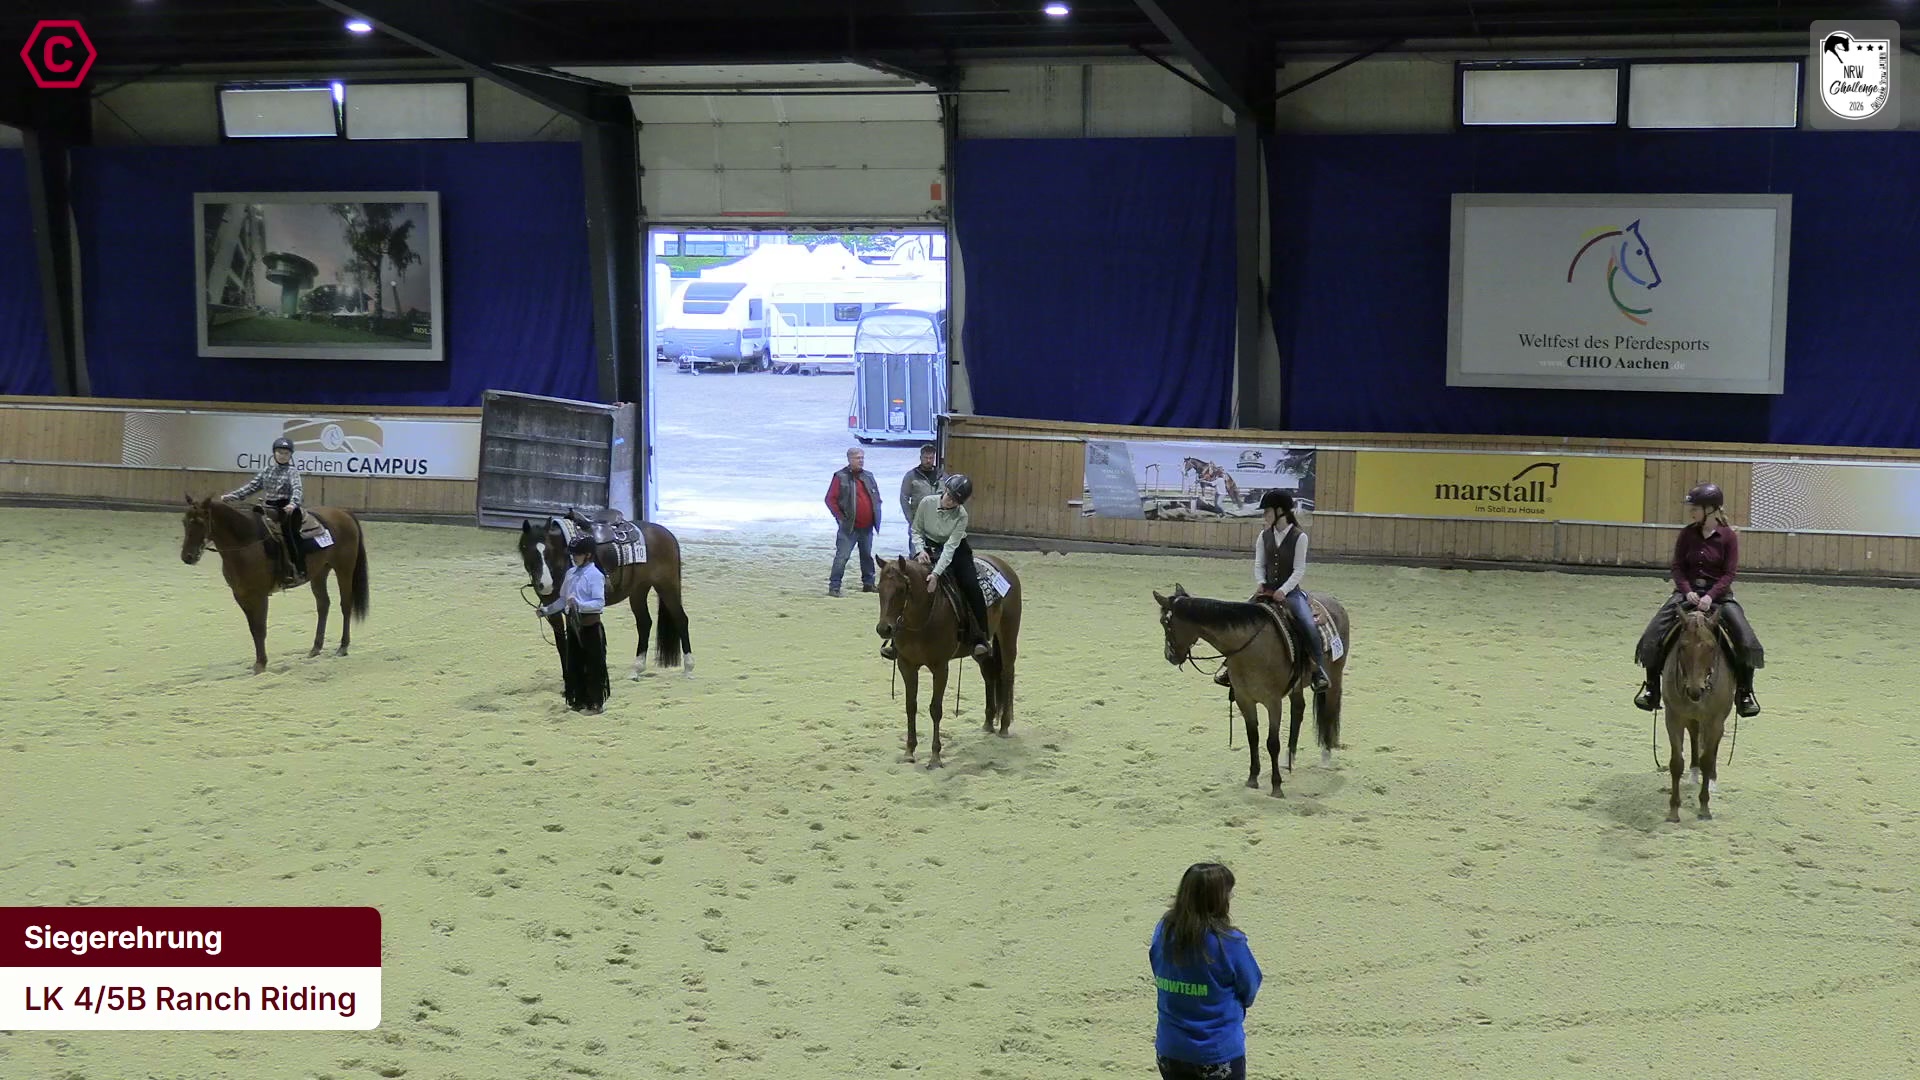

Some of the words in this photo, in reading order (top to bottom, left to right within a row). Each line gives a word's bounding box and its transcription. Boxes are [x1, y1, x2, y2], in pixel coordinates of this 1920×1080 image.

[1519, 333, 1580, 350] Weltfest
[1584, 334, 1609, 350] des
[1615, 335, 1710, 354] Pferdesports
[1566, 355, 1612, 370] CHIO
[1615, 356, 1670, 371] Aachen
[346, 456, 428, 475] CAMPUS
[1434, 480, 1545, 503] marstall
